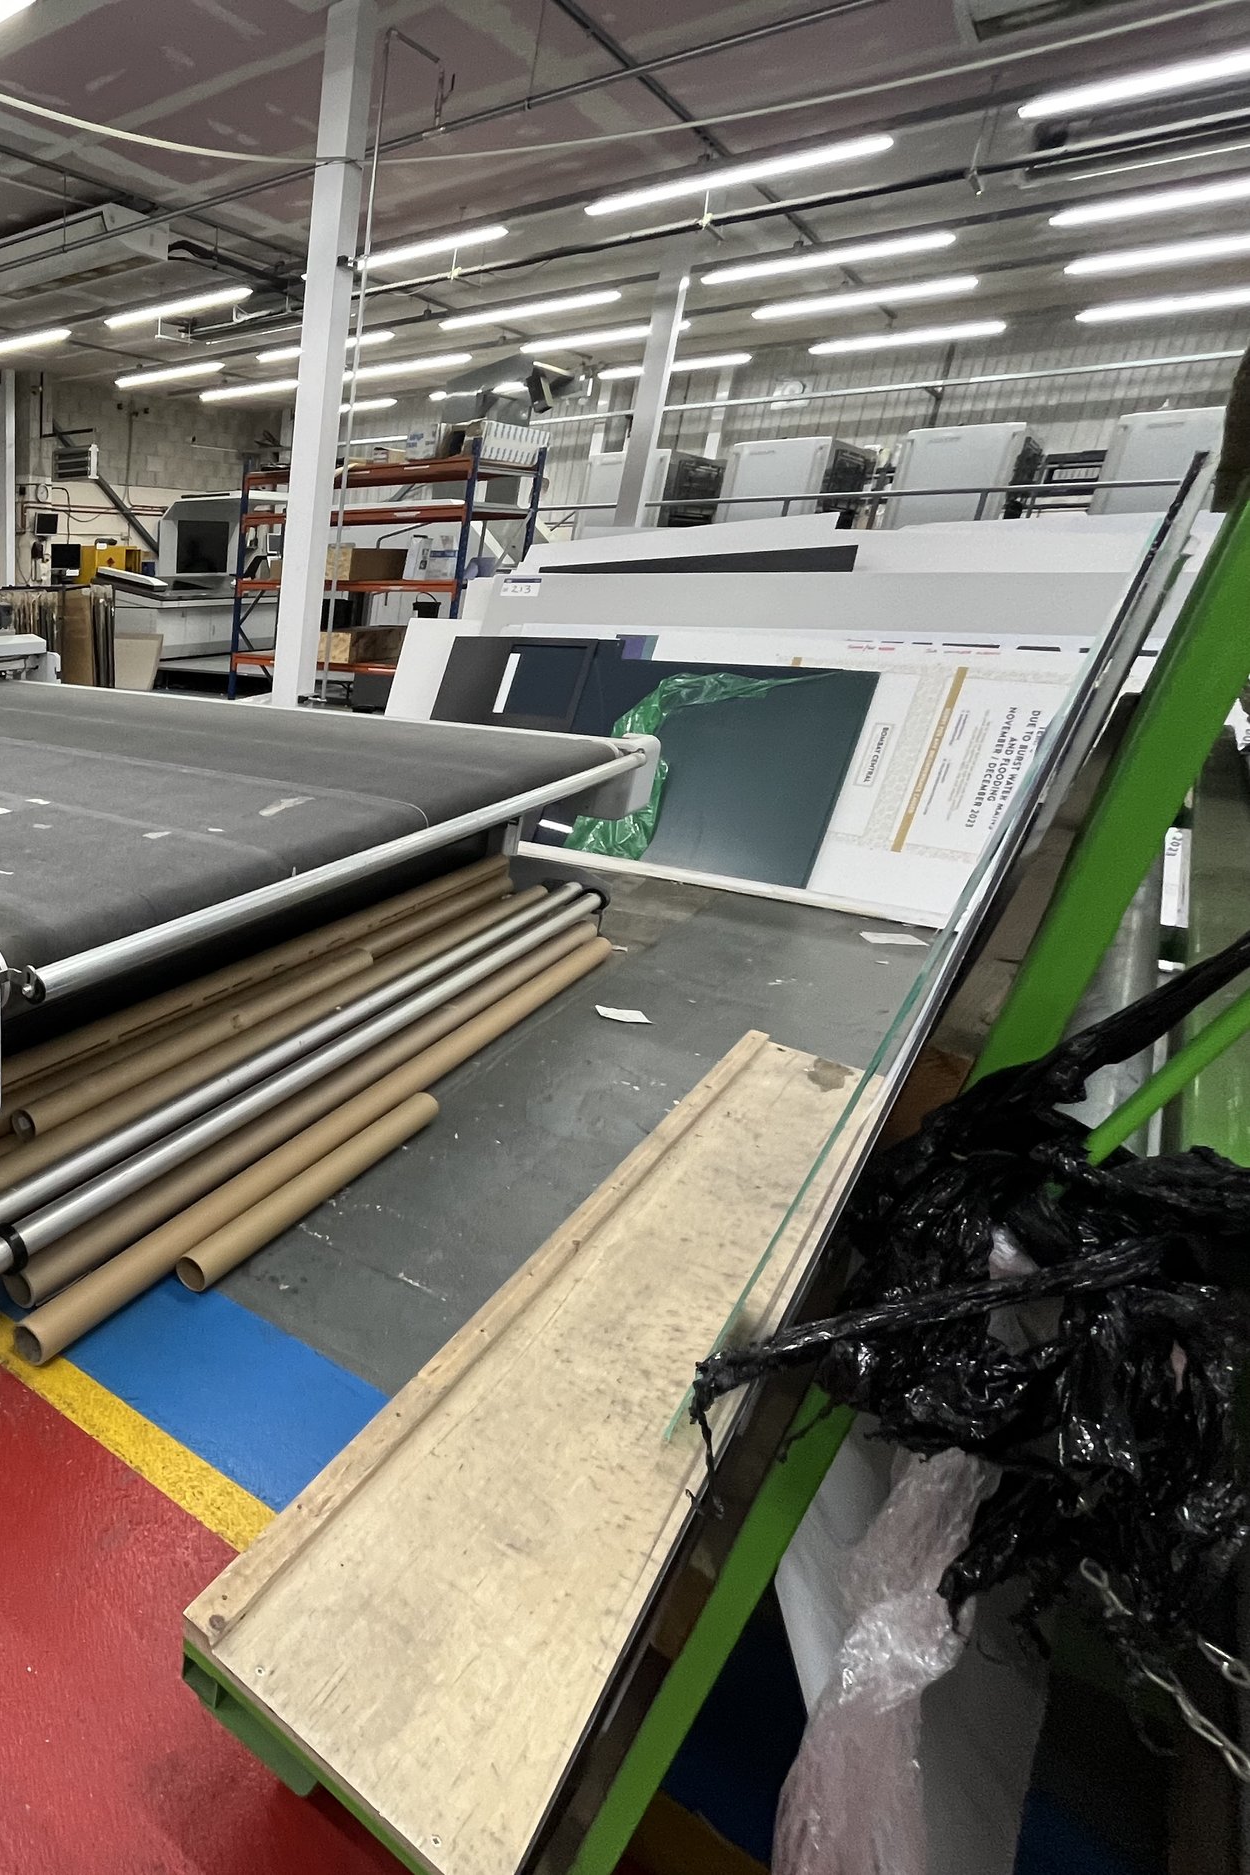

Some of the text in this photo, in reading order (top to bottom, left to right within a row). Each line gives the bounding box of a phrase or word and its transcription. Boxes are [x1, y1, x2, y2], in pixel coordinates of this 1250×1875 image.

[993, 707, 1018, 754] NOVEMBER
[1026, 710, 1042, 728] DUE
[1022, 731, 1034, 742] TO
[863, 727, 890, 783] BOMBAY CENTRAL
[1011, 744, 1028, 771] BURST
[987, 737, 1017, 802] AND FLOODING
[973, 762, 997, 807] DECEMBER
[999, 774, 1018, 801] WATER
[965, 809, 980, 828] 2023
